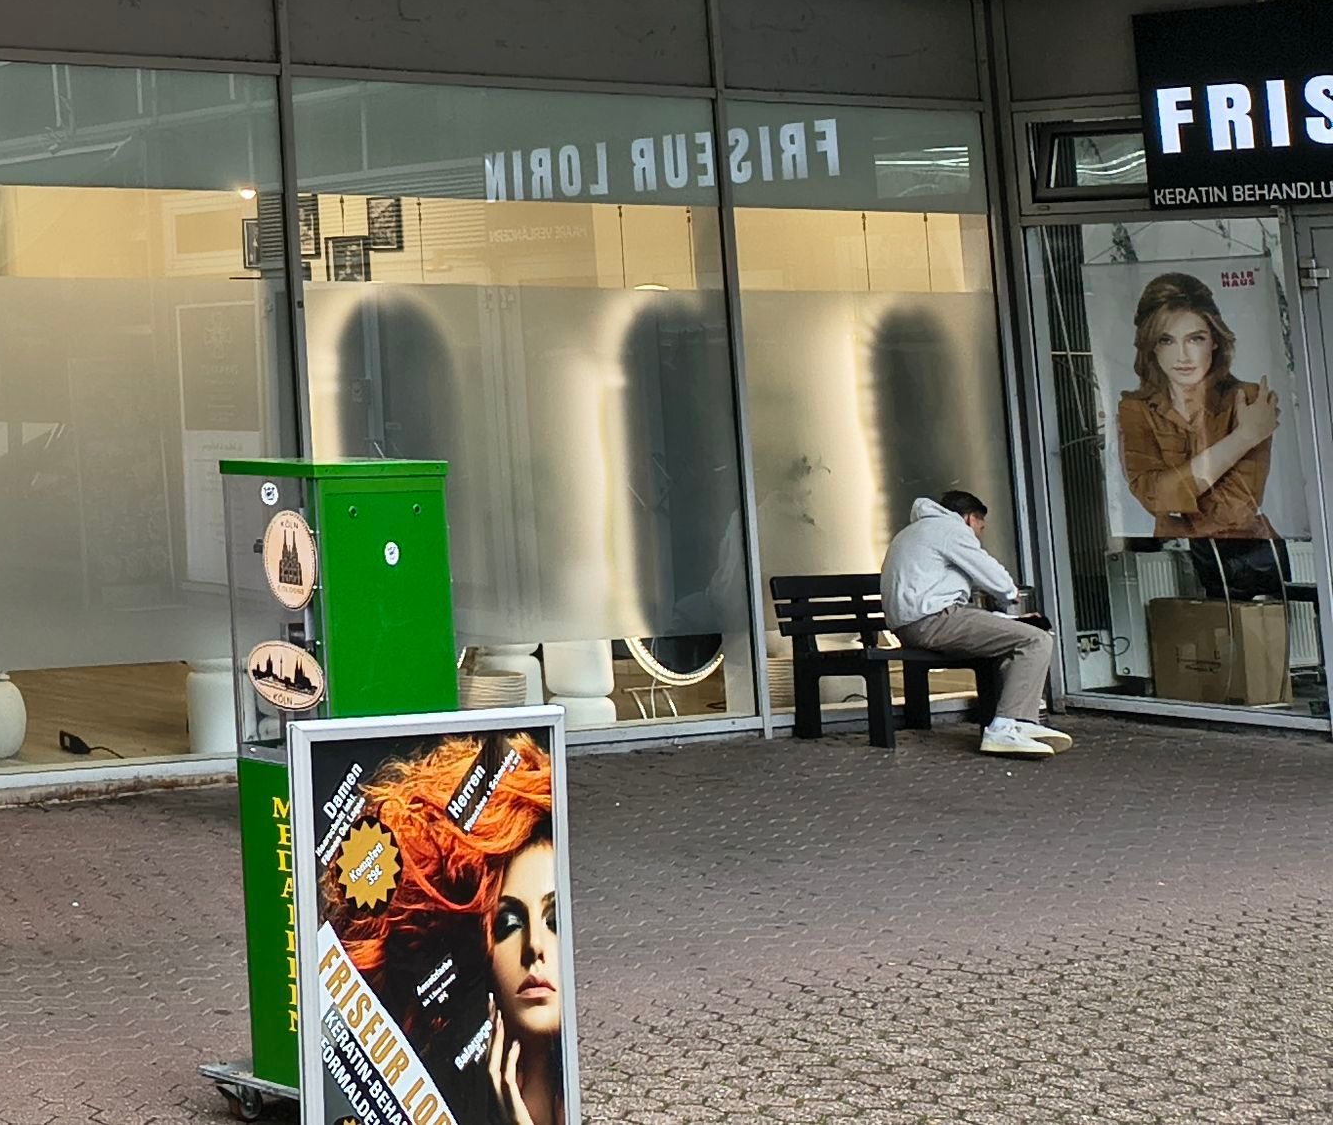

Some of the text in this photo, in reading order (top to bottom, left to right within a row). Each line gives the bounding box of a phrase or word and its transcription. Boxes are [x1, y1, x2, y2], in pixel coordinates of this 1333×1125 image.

[1156, 74, 1333, 154] FRIS
[1154, 186, 1227, 205] KERATIN
[273, 692, 293, 706] KÖLN
[323, 762, 363, 820] Damen
[447, 764, 486, 819] Herren
[319, 945, 410, 1087] FRISEUR
